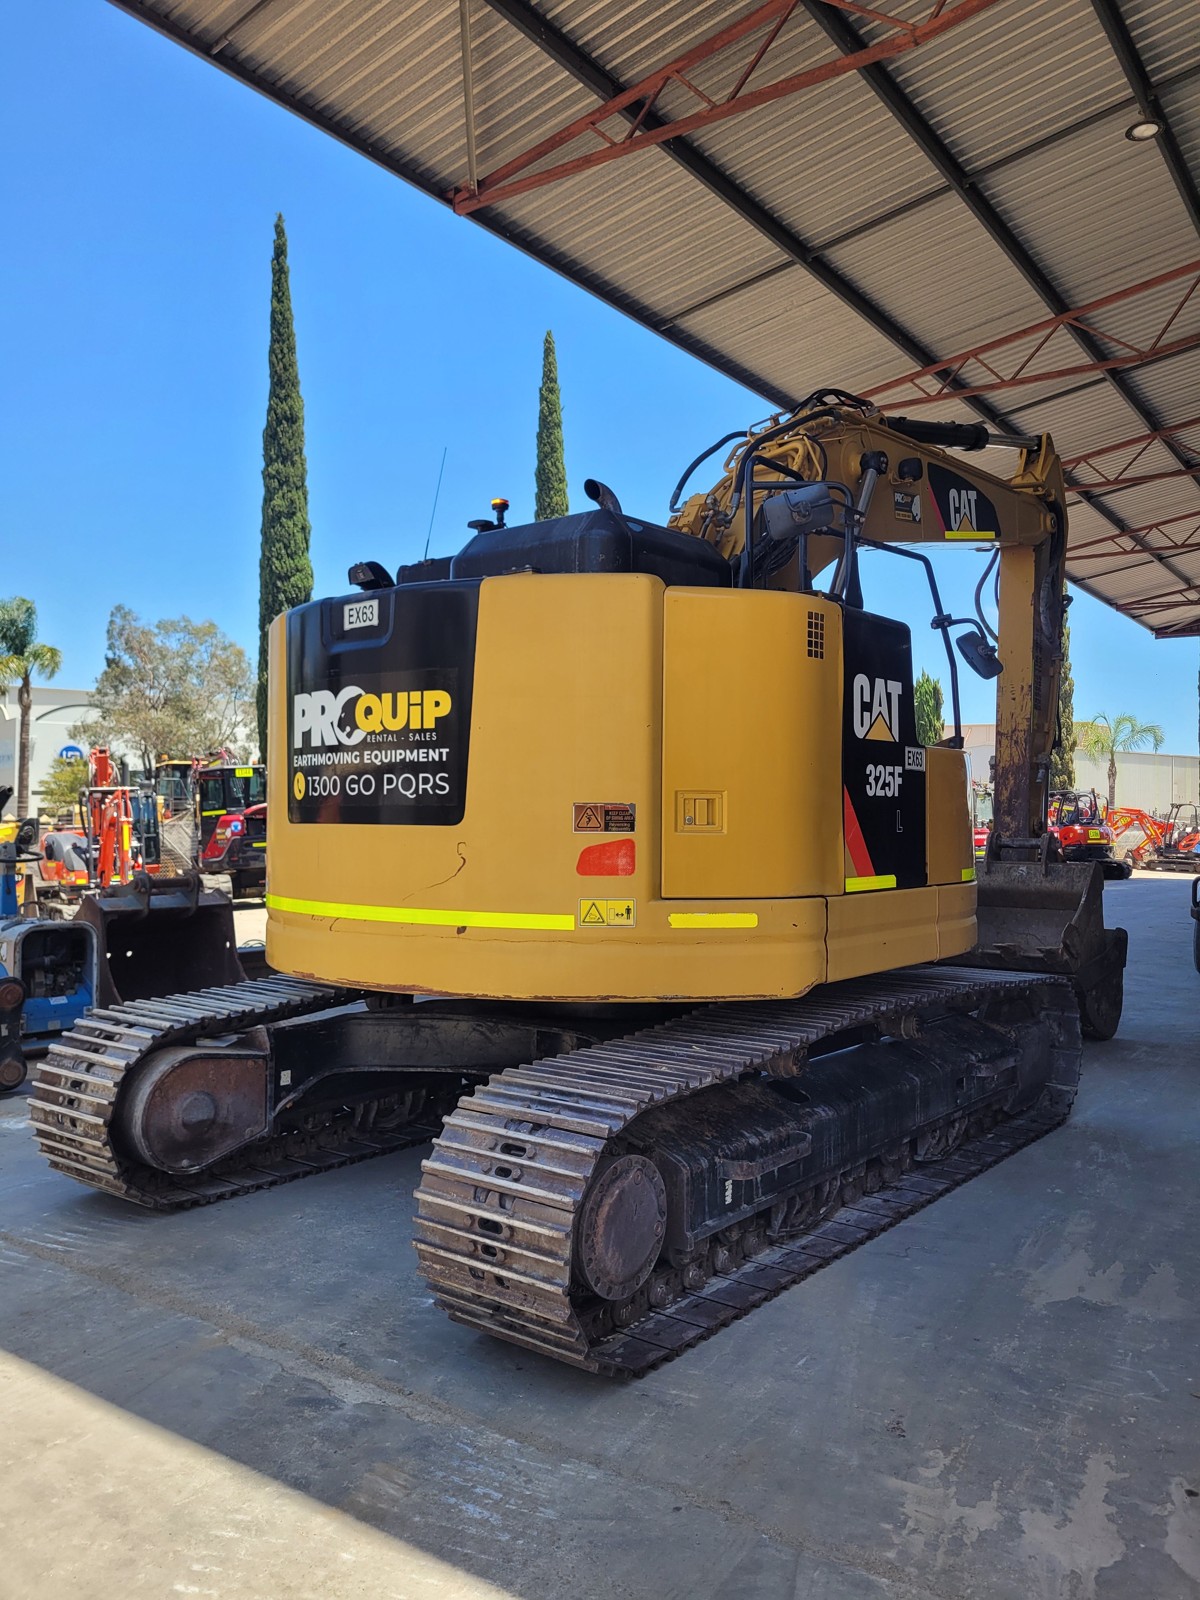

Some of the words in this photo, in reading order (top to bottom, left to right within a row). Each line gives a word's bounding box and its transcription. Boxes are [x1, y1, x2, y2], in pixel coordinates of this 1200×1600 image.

[949, 488, 977, 531] CAT
[349, 604, 374, 625] EX63
[853, 673, 902, 742] CAT
[367, 734, 397, 743] RENTAL
[409, 732, 437, 741] SALES
[294, 751, 360, 767] EARTHMOVING
[364, 748, 449, 765] EQUIPMENT
[907, 750, 923, 767] EX63
[307, 775, 341, 797] 1300
[345, 774, 375, 796] GO
[383, 773, 450, 799] PQRS
[866, 764, 902, 797] 325F
